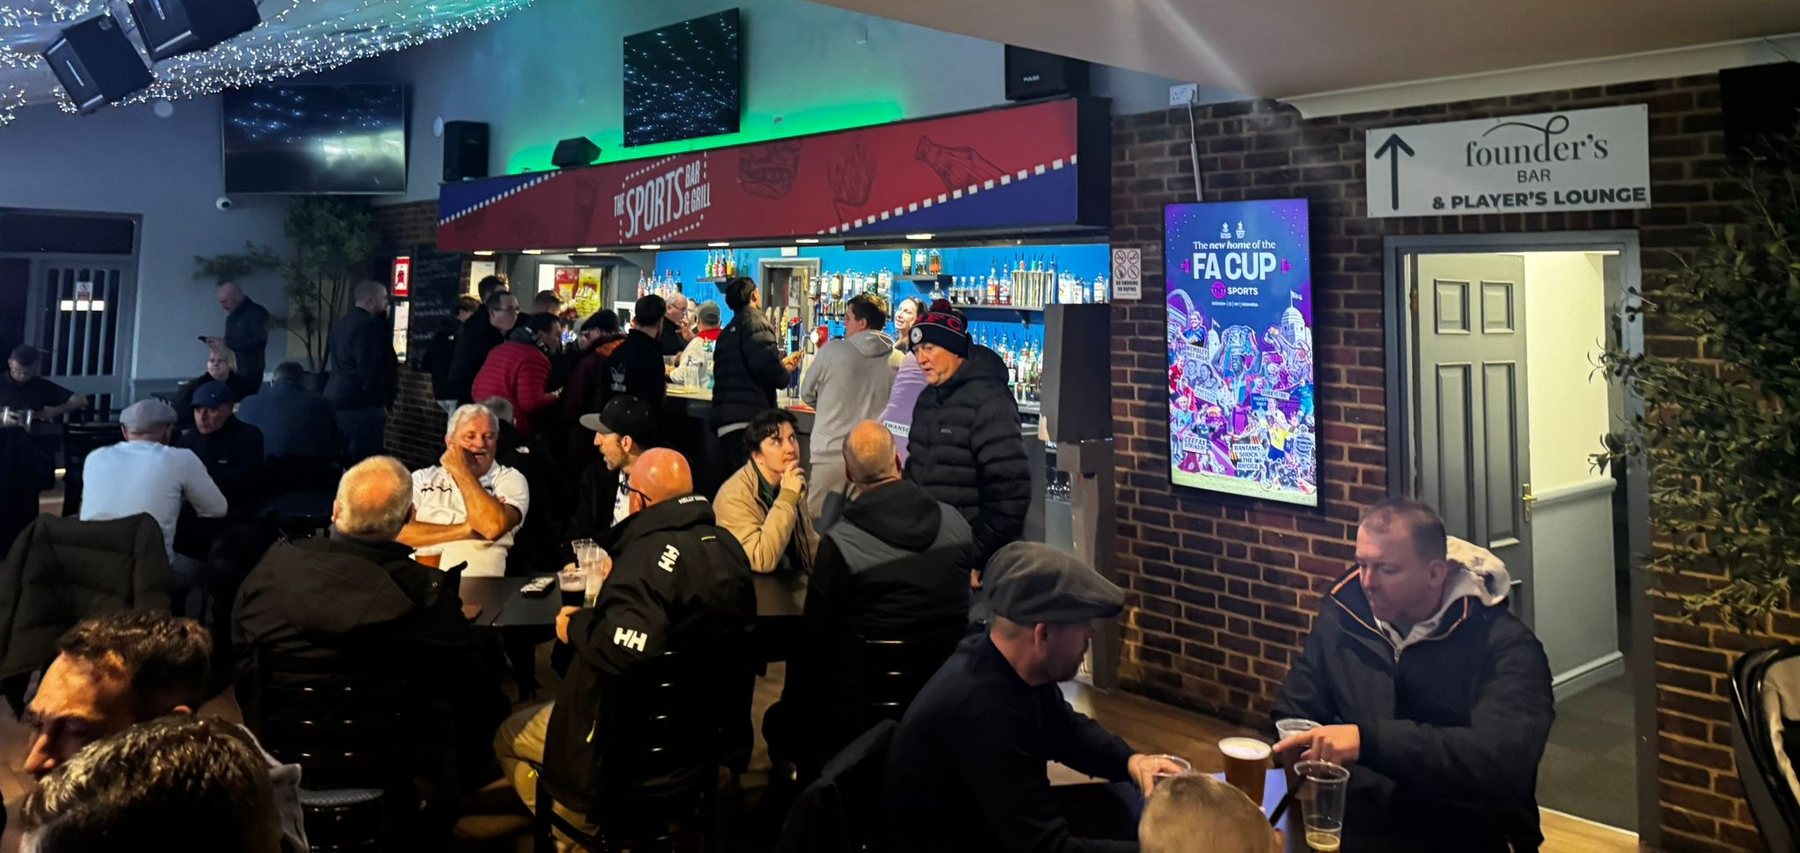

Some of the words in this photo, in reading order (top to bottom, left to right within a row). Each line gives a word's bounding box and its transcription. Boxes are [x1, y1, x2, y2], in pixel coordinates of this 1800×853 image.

[1465, 115, 1608, 167] founder's
[685, 160, 700, 189] BAR
[1517, 169, 1551, 184] BAR
[613, 192, 625, 218] THE
[625, 166, 684, 239] SPORTS
[684, 190, 691, 216] &
[691, 182, 711, 213] GRILL
[1432, 196, 1445, 210] &
[1451, 191, 1548, 209] PLAYER'S
[1554, 186, 1647, 205] LOUNGE
[1193, 241, 1208, 250] The
[1209, 241, 1226, 250] new
[1226, 240, 1251, 250] home
[1251, 239, 1261, 250] of
[1261, 240, 1276, 249] the
[1193, 252, 1222, 280] FA
[1224, 251, 1277, 281] CUP
[1227, 287, 1259, 296] SPORTS
[657, 544, 680, 573] HH
[613, 627, 648, 652] HH
